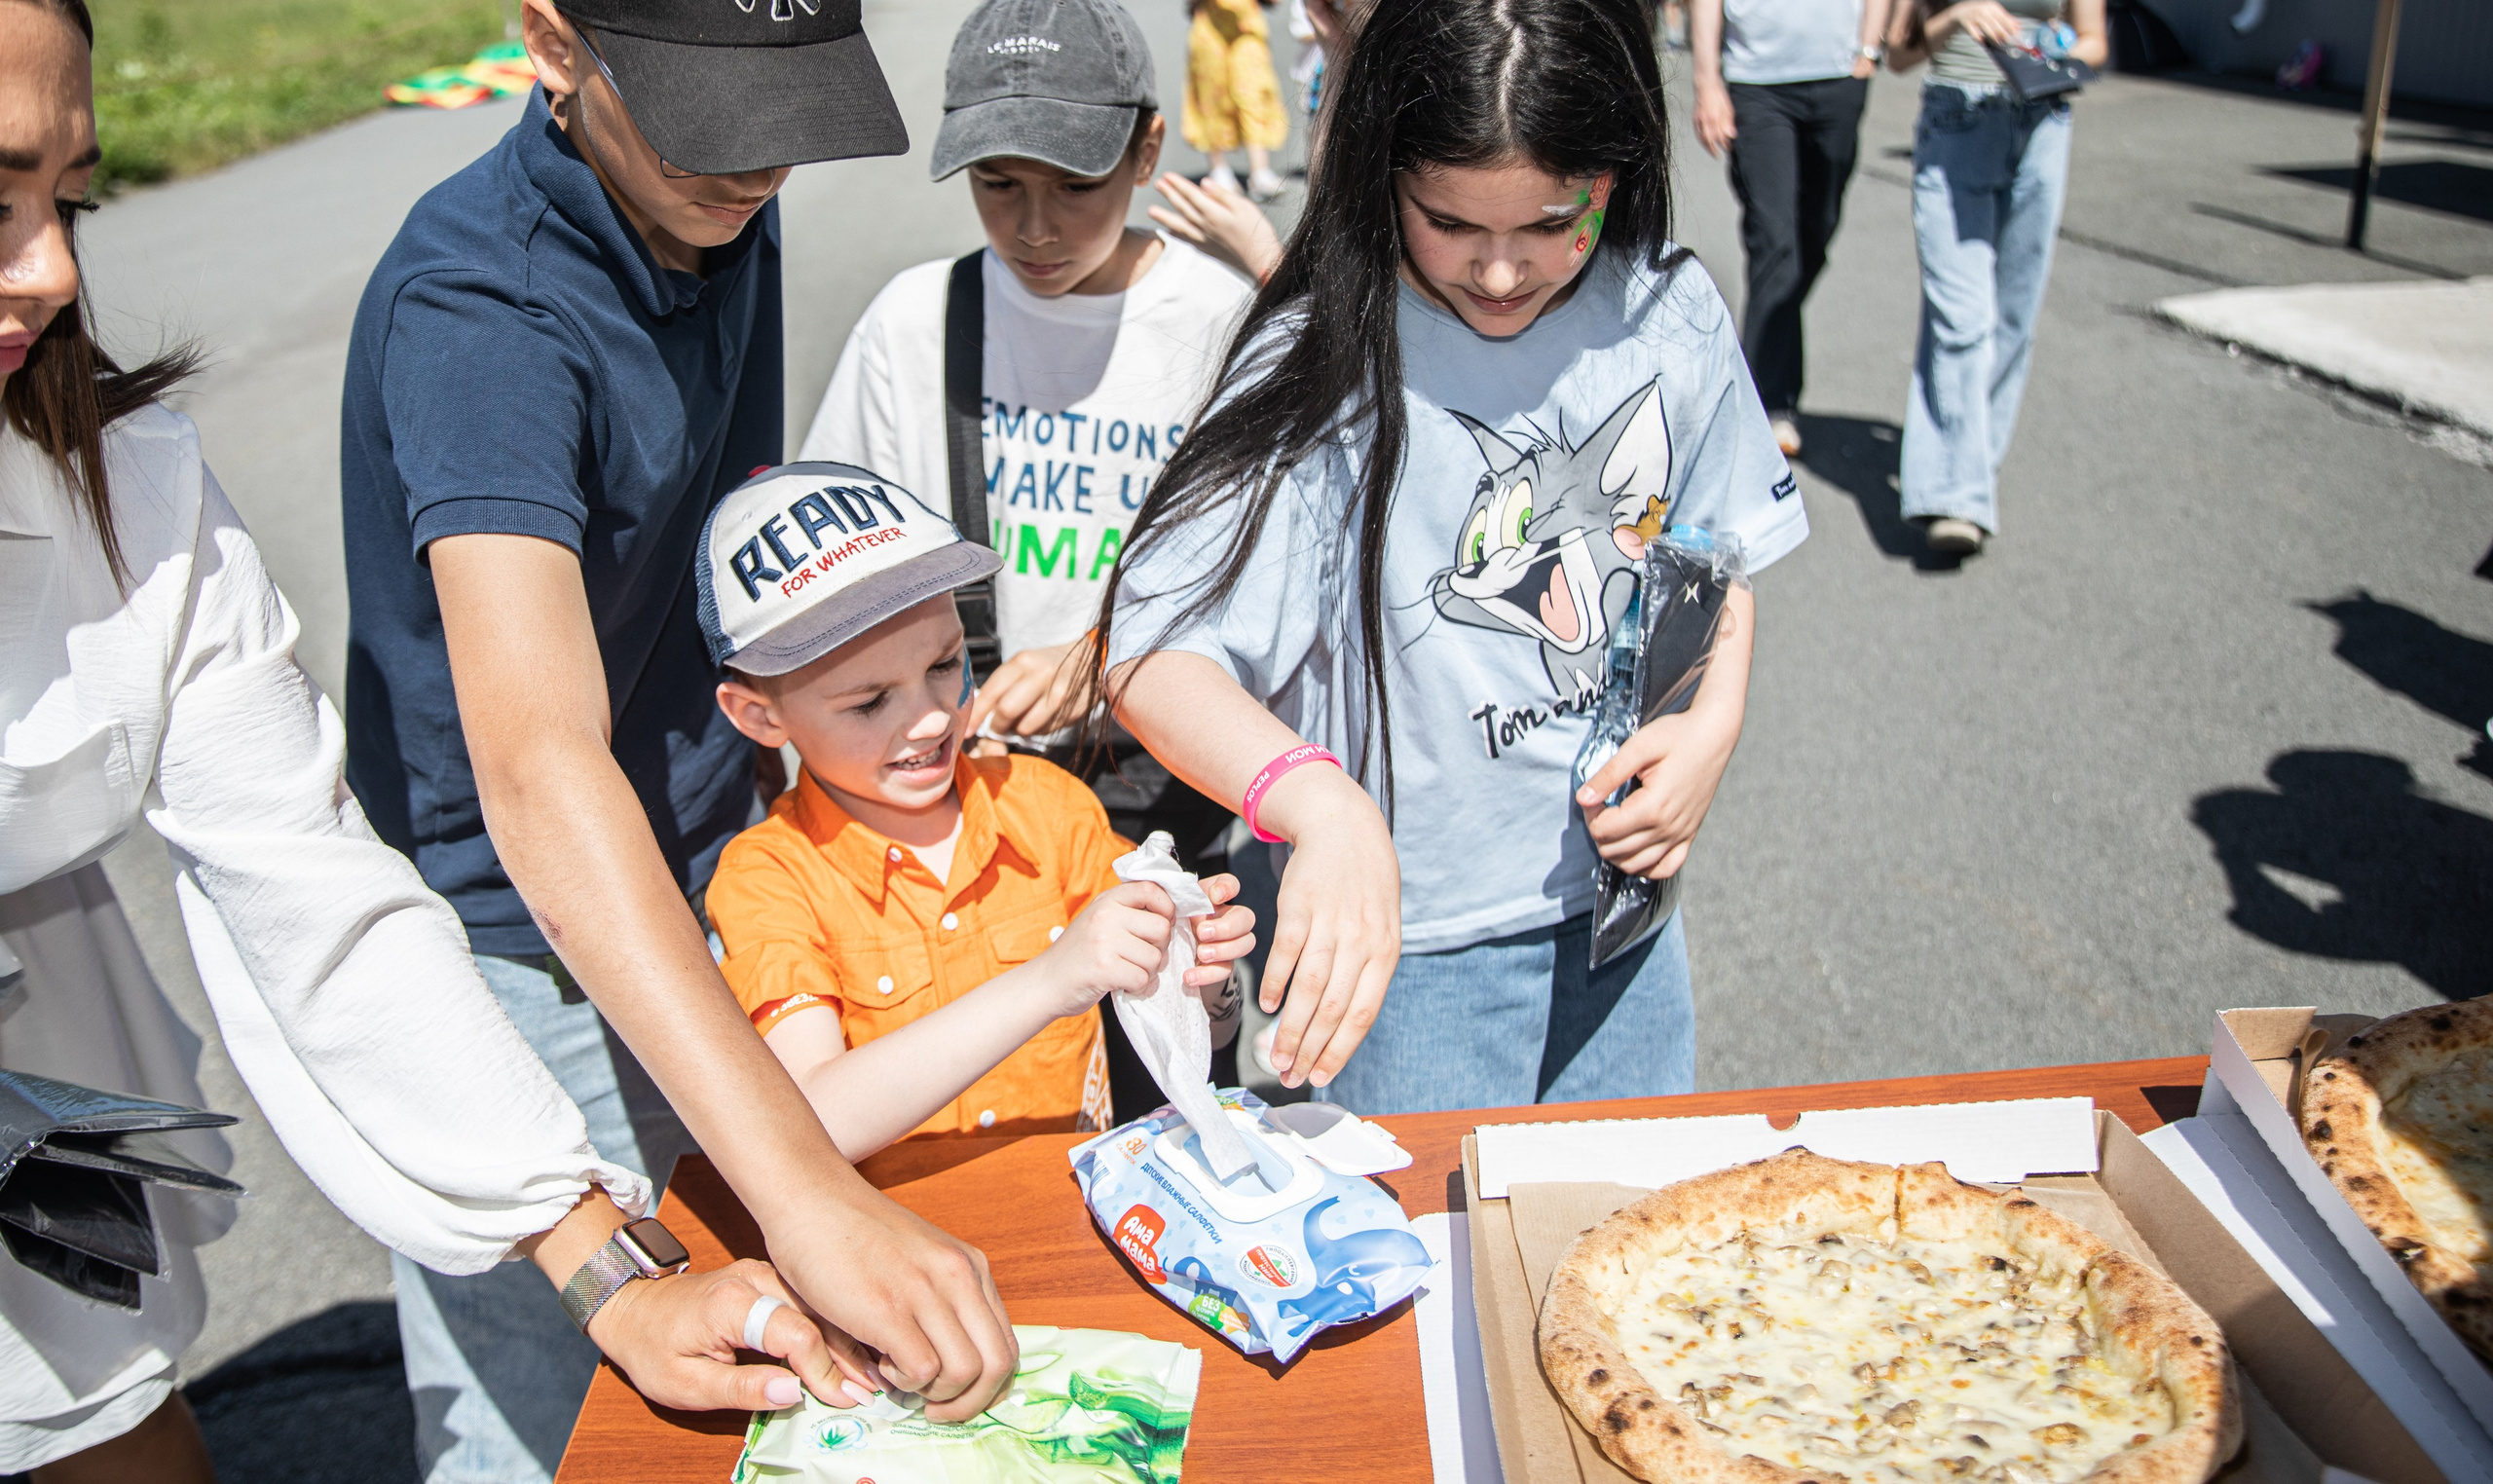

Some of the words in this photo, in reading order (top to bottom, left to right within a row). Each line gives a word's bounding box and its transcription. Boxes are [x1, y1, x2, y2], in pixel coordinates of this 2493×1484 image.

[1119, 473, 1149, 510] U
[728, 484, 907, 603] READY
[780, 566, 818, 599] FOR
[817, 527, 908, 575] WHATEVER
[991, 518, 1124, 580] UMA
[1470, 701, 1547, 759] Tom
[1126, 1136, 1148, 1156] 80
[1140, 1162, 1165, 1185] ДЕТСКИЕ
[1161, 1179, 1192, 1209] ВЛАЖНЫЕ
[1187, 1206, 1223, 1244] САЛФЕТКИ
[1201, 1295, 1221, 1312] БЕЗ
